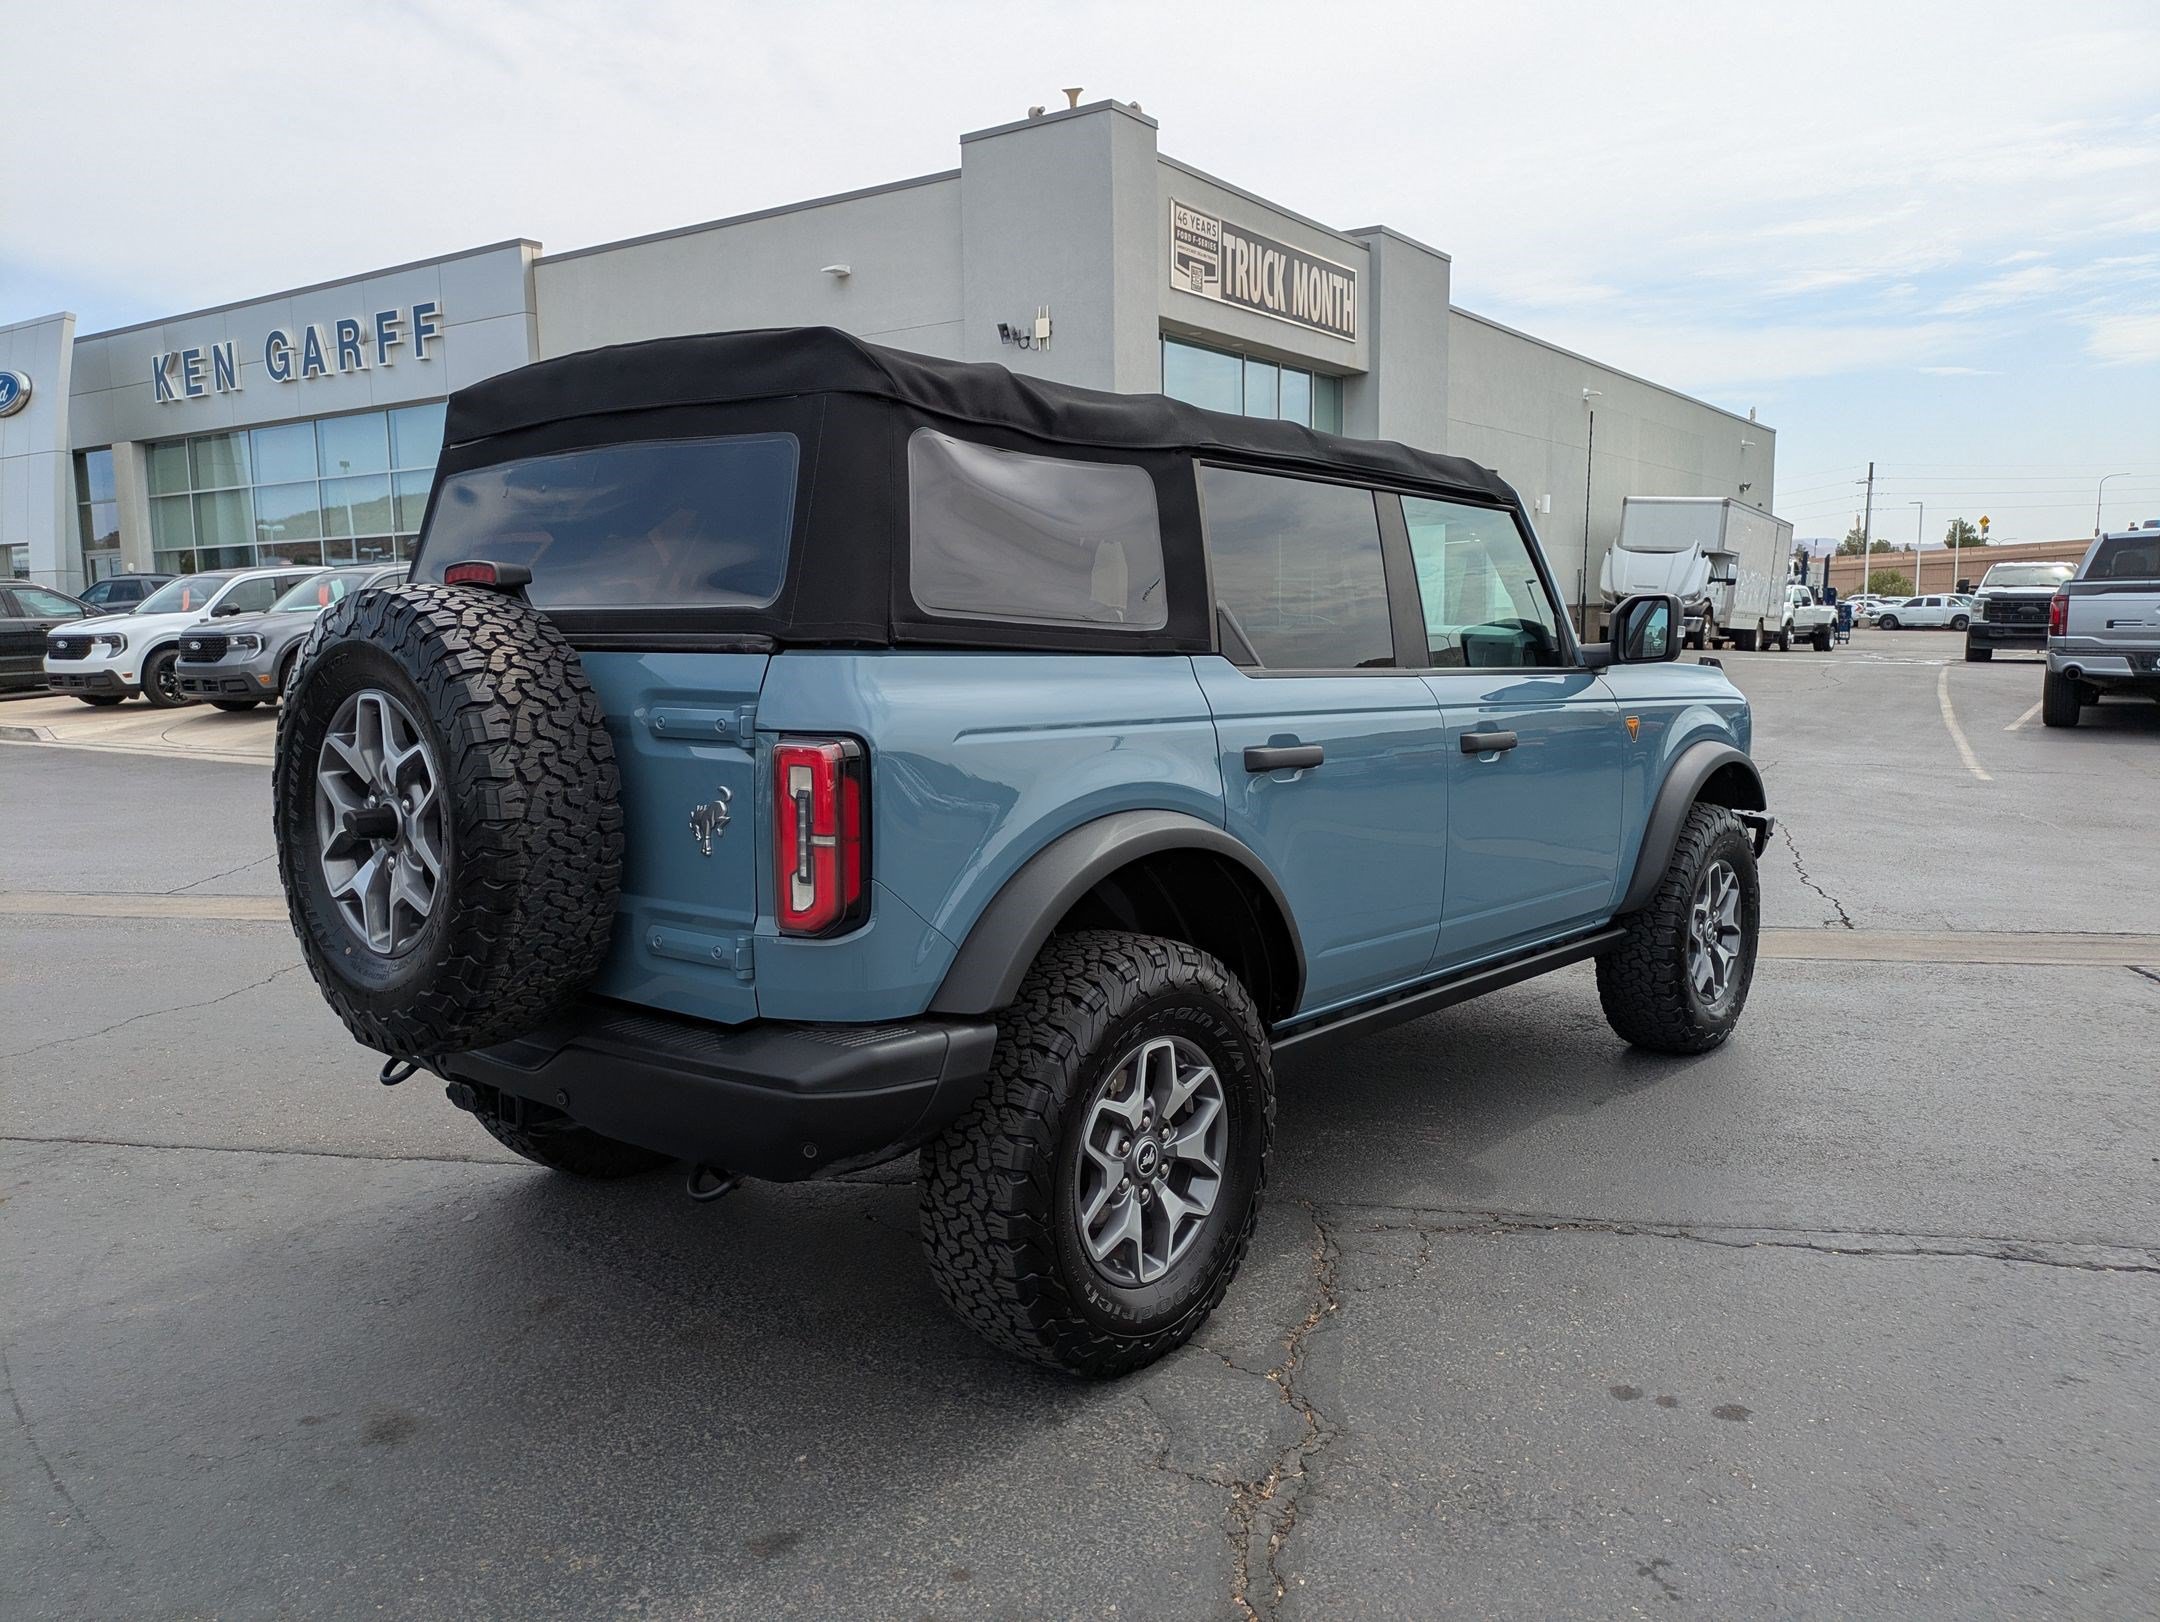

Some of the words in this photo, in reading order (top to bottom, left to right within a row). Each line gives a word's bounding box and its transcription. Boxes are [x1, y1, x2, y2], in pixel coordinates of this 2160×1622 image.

[1176, 229, 1192, 242] FORD
[1192, 234, 1217, 252] F-SERIES
[1177, 210, 1188, 226] 46
[1189, 214, 1217, 237] YEARS
[1223, 232, 1287, 312] TRUCK
[1292, 258, 1355, 334] MONTH
[151, 340, 242, 404] KEN
[264, 300, 443, 385] GARFF
